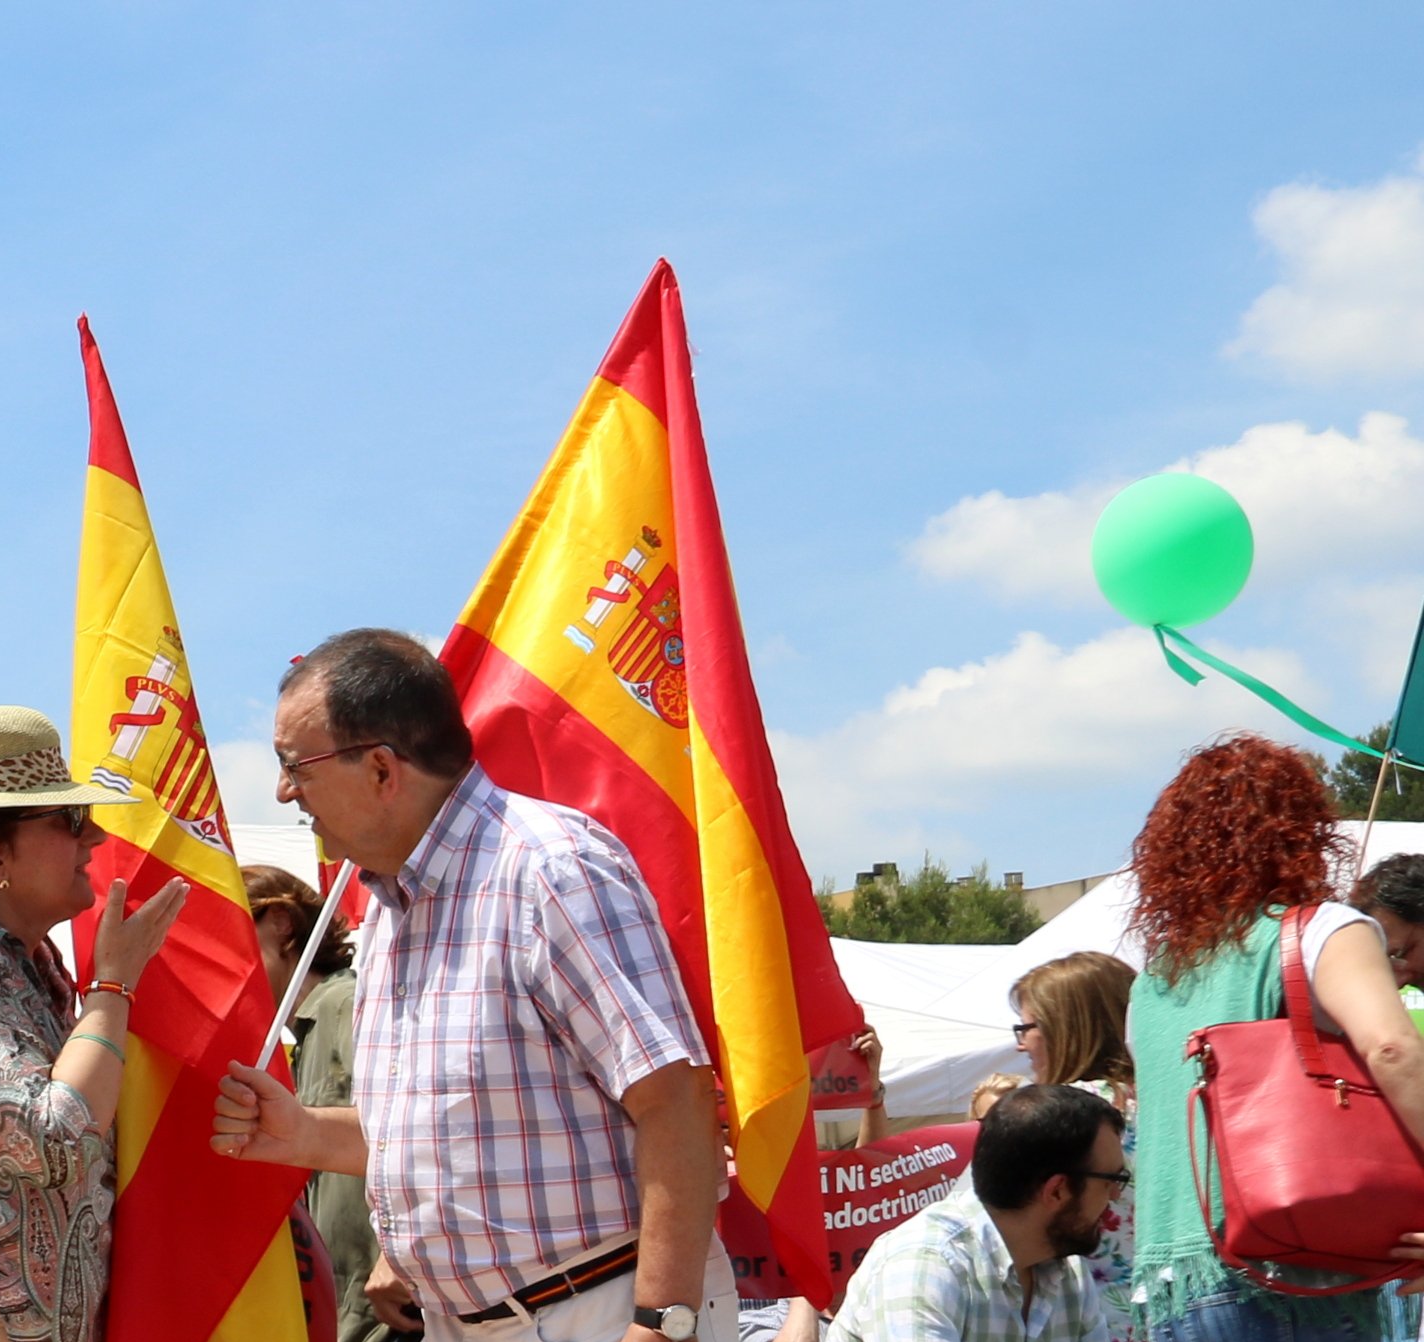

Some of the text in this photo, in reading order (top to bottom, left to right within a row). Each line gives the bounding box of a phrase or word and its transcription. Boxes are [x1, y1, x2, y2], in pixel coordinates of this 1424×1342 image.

[136, 678, 175, 701] PLVS
[836, 1164, 865, 1194] Ni
[870, 1141, 957, 1188] sectarismo
